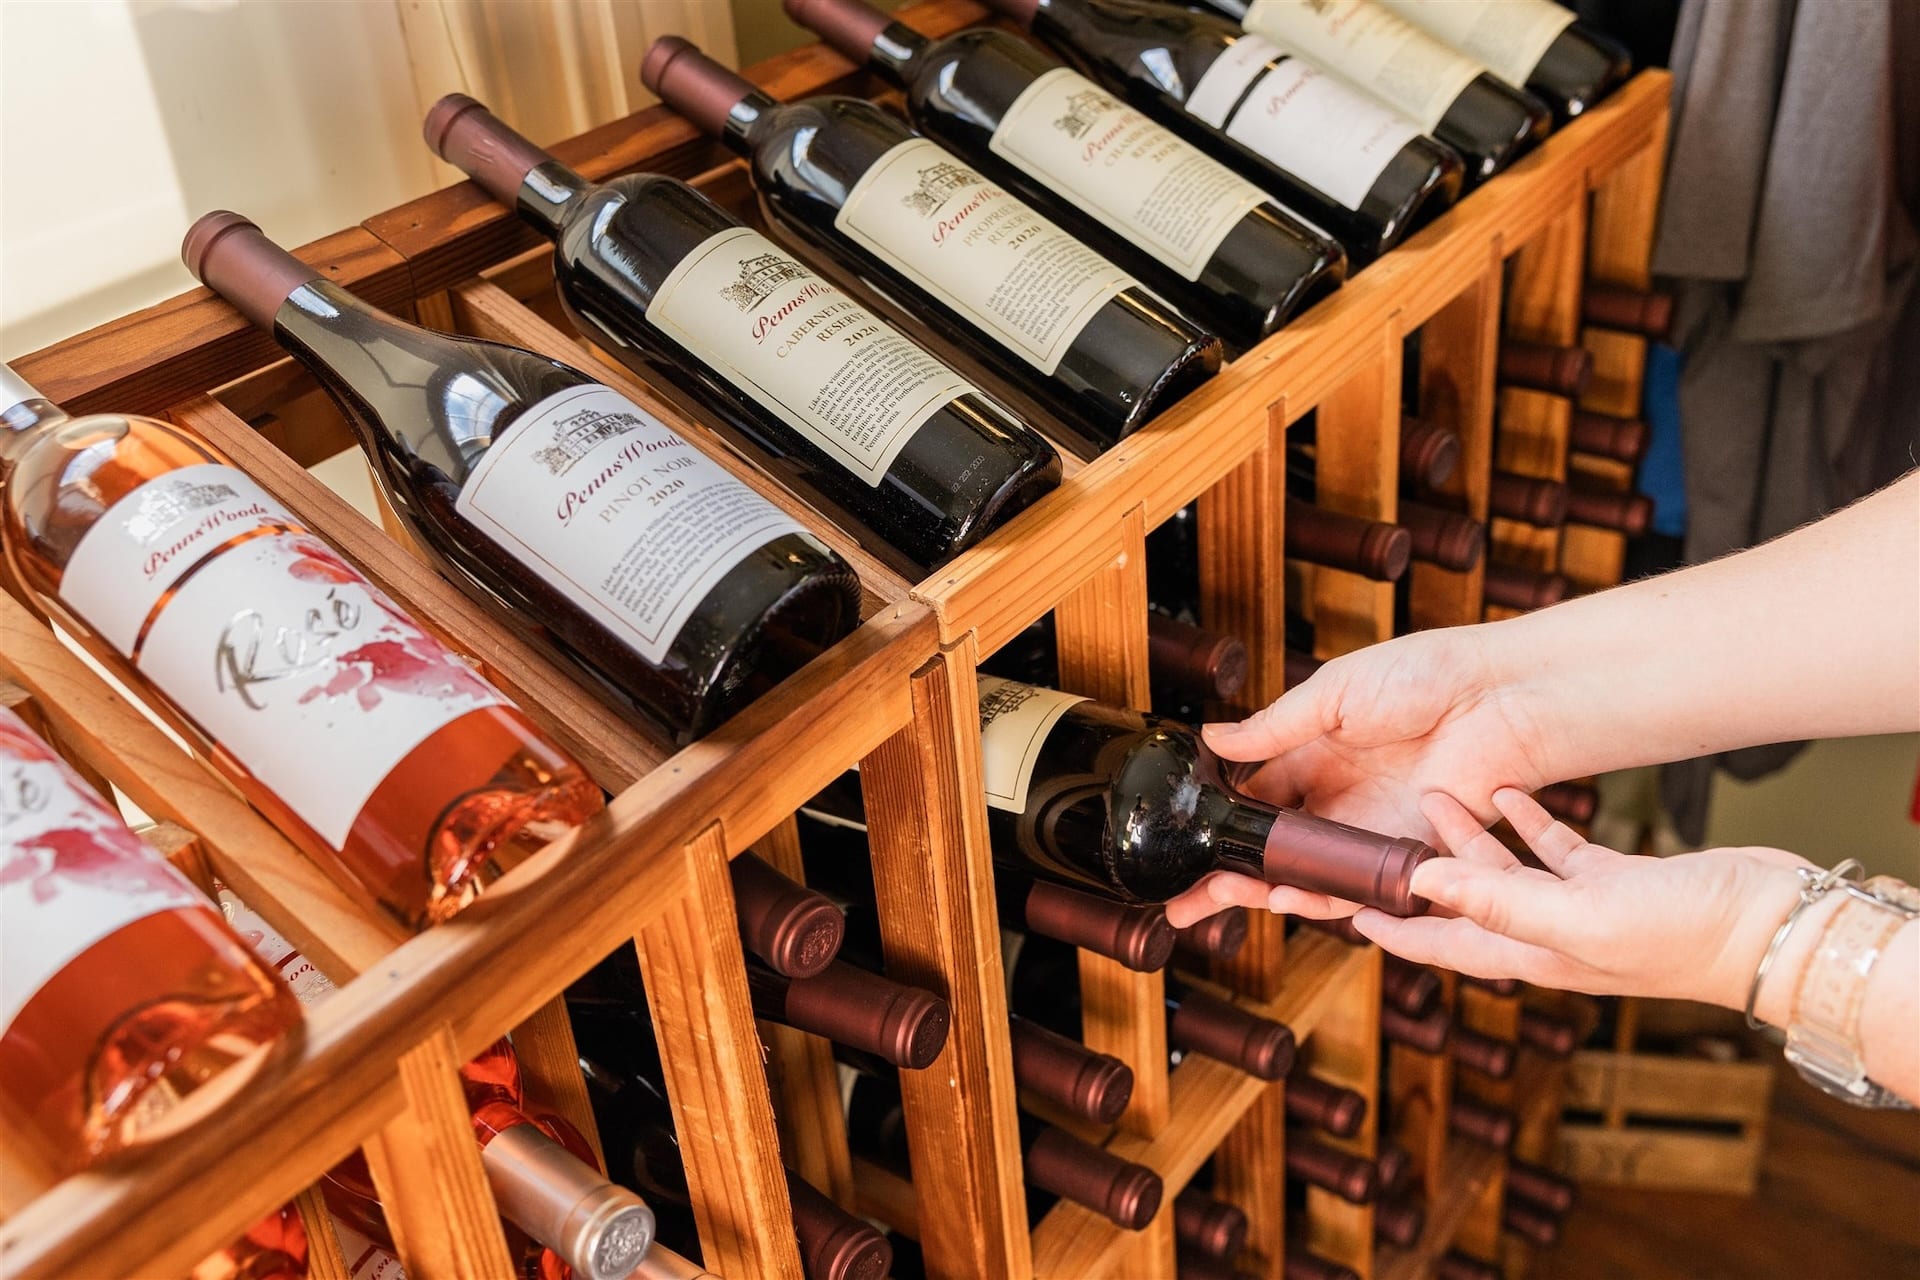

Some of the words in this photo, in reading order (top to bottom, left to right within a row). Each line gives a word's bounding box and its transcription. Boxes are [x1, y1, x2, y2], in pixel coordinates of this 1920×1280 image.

[1008, 224, 1041, 250] 2020
[776, 303, 840, 359] CABERNET
[843, 325, 879, 347] 2020
[808, 394, 821, 410] Like
[818, 383, 830, 394] the
[828, 358, 854, 384] visionary
[852, 342, 874, 359] William
[816, 397, 829, 415] with
[827, 386, 837, 398] the
[837, 368, 855, 388] future
[829, 412, 841, 425] this
[839, 395, 854, 412] wine
[853, 367, 881, 397] represents
[834, 372, 865, 402] technology
[863, 362, 875, 372] and
[836, 411, 852, 431] holds
[850, 395, 864, 411] with
[864, 377, 883, 397] regard
[843, 407, 866, 436] devoted
[865, 392, 879, 408] wine
[850, 410, 875, 441] tradition,
[878, 385, 899, 408] portion
[898, 374, 912, 387] from
[857, 431, 868, 446] will
[867, 422, 876, 431] be
[875, 406, 889, 423] used
[887, 399, 896, 407] to
[894, 378, 924, 400] furthering
[600, 474, 652, 523] PINOT
[653, 456, 697, 478] NOIR
[647, 479, 686, 507] 2020
[144, 503, 268, 580] PennsWoods
[216, 587, 361, 711] Rosé
